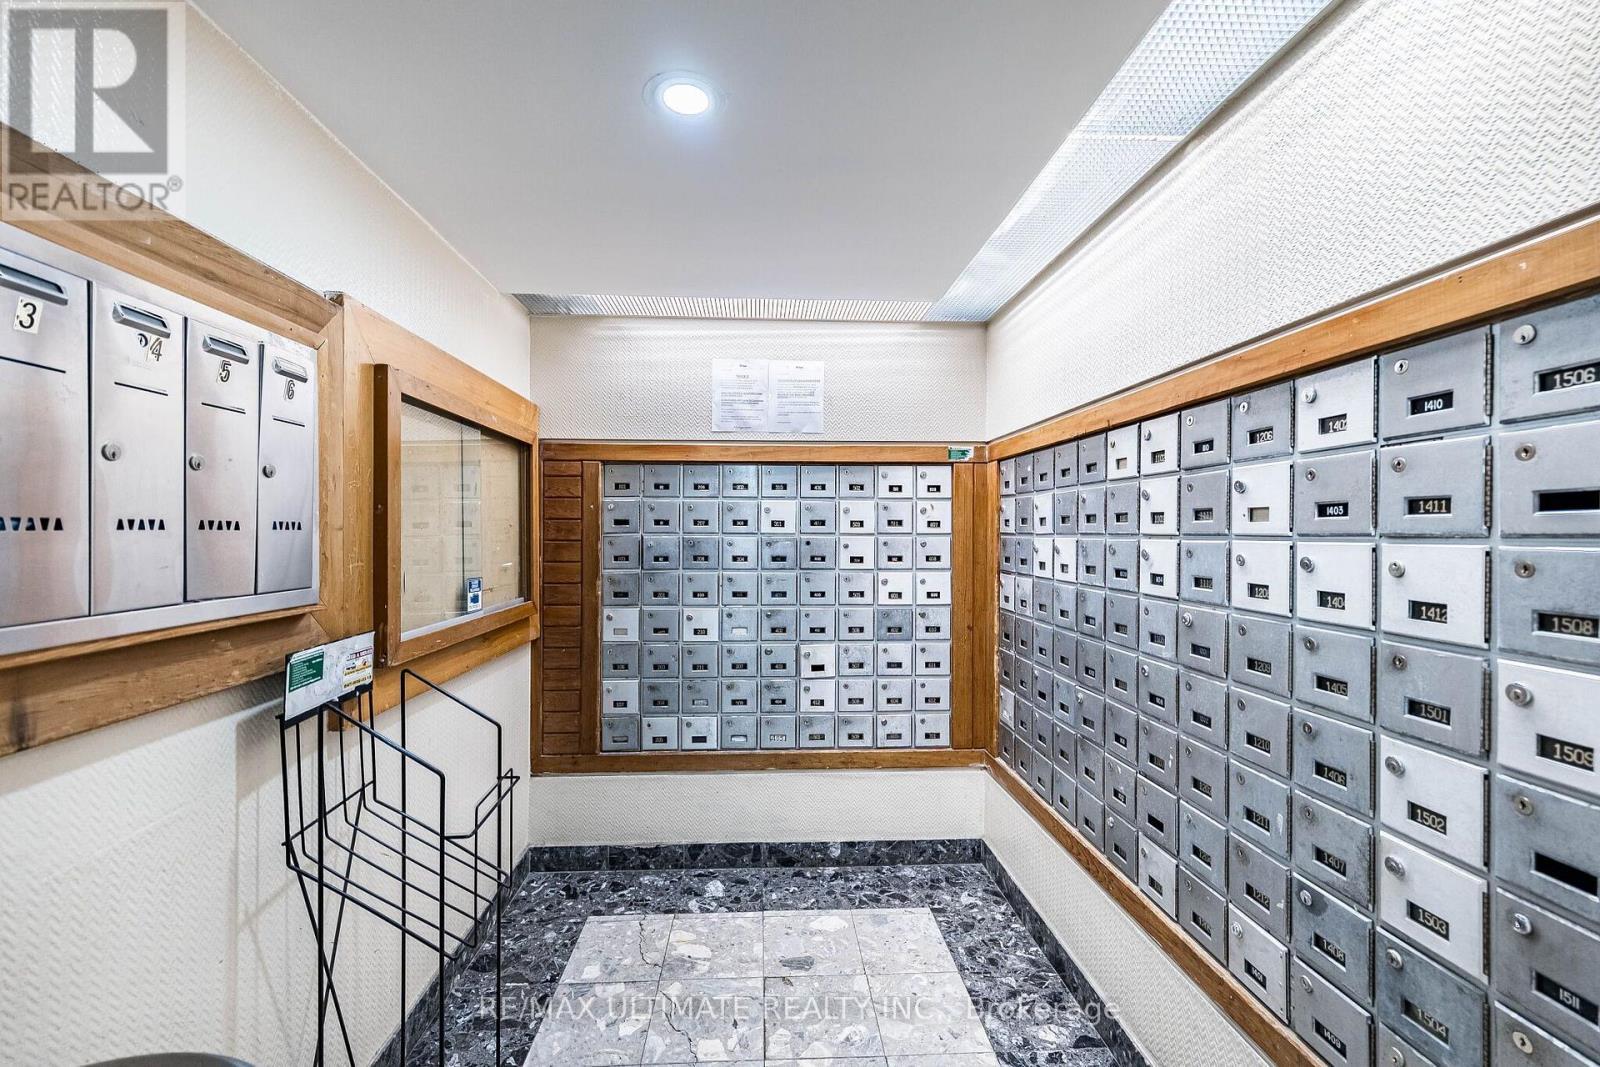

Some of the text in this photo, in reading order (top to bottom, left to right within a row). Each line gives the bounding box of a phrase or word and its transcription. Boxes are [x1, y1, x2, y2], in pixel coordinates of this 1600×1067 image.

[19, 302, 37, 329] 3
[150, 337, 162, 361] 4
[219, 361, 232, 382] 5
[1553, 367, 1596, 389] 1506
[287, 380, 296, 400] 6
[1424, 398, 1443, 411] 1410
[1256, 430, 1273, 443] 1206
[1326, 505, 1344, 516] 1403
[1418, 500, 1447, 513] 1411
[1327, 596, 1345, 608] 140
[1420, 606, 1448, 621] 1412
[1551, 616, 1593, 634] 1508
[1326, 681, 1348, 696] 1405
[1420, 703, 1448, 723] 1501
[1254, 737, 1270, 752] 1210
[1322, 766, 1346, 786] 1406
[1253, 812, 1269, 829] 1211
[1416, 809, 1446, 833] 1502
[1322, 852, 1345, 873] 1407
[1253, 889, 1269, 907] 1212
[1417, 909, 1447, 934] 1503
[1322, 938, 1345, 962] 1408
[1559, 988, 1580, 1010] 1511
[1416, 1008, 1447, 1036] 1504
[1323, 1026, 1341, 1047] 1409
